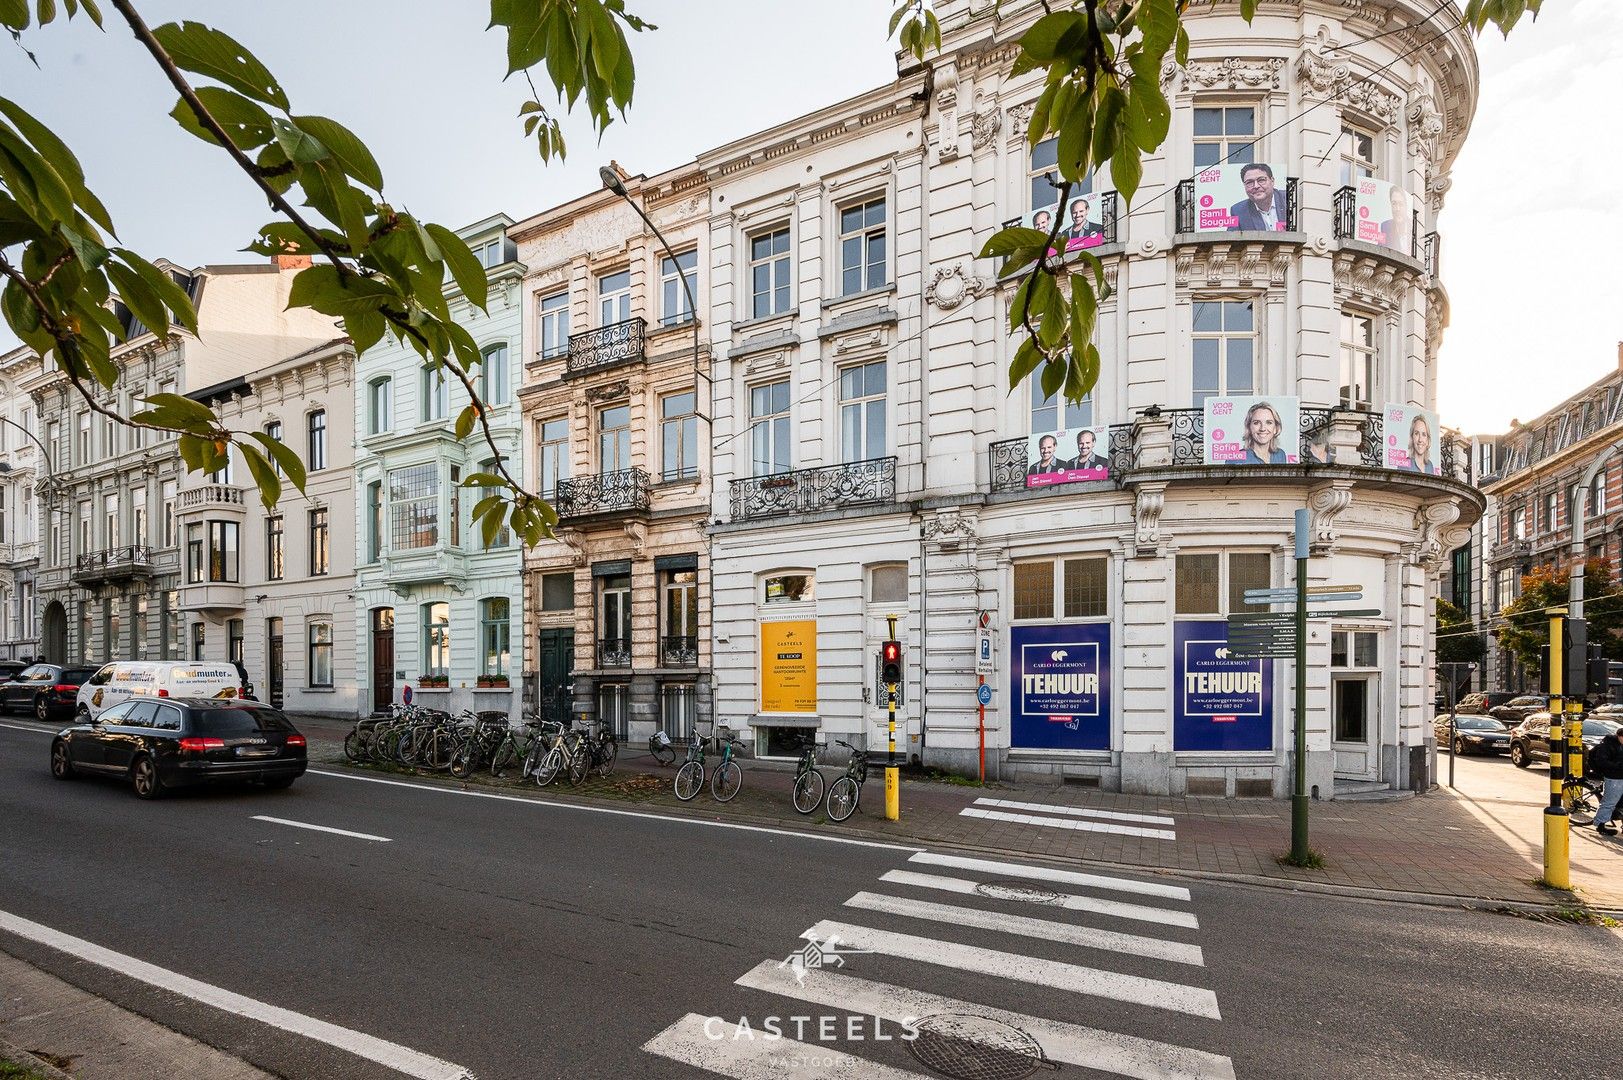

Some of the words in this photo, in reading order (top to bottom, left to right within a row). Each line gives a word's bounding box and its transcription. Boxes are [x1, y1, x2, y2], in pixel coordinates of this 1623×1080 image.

[1201, 210, 1223, 218] Sami
[1201, 217, 1235, 227] Souguir
[1213, 452, 1243, 460] Bracke
